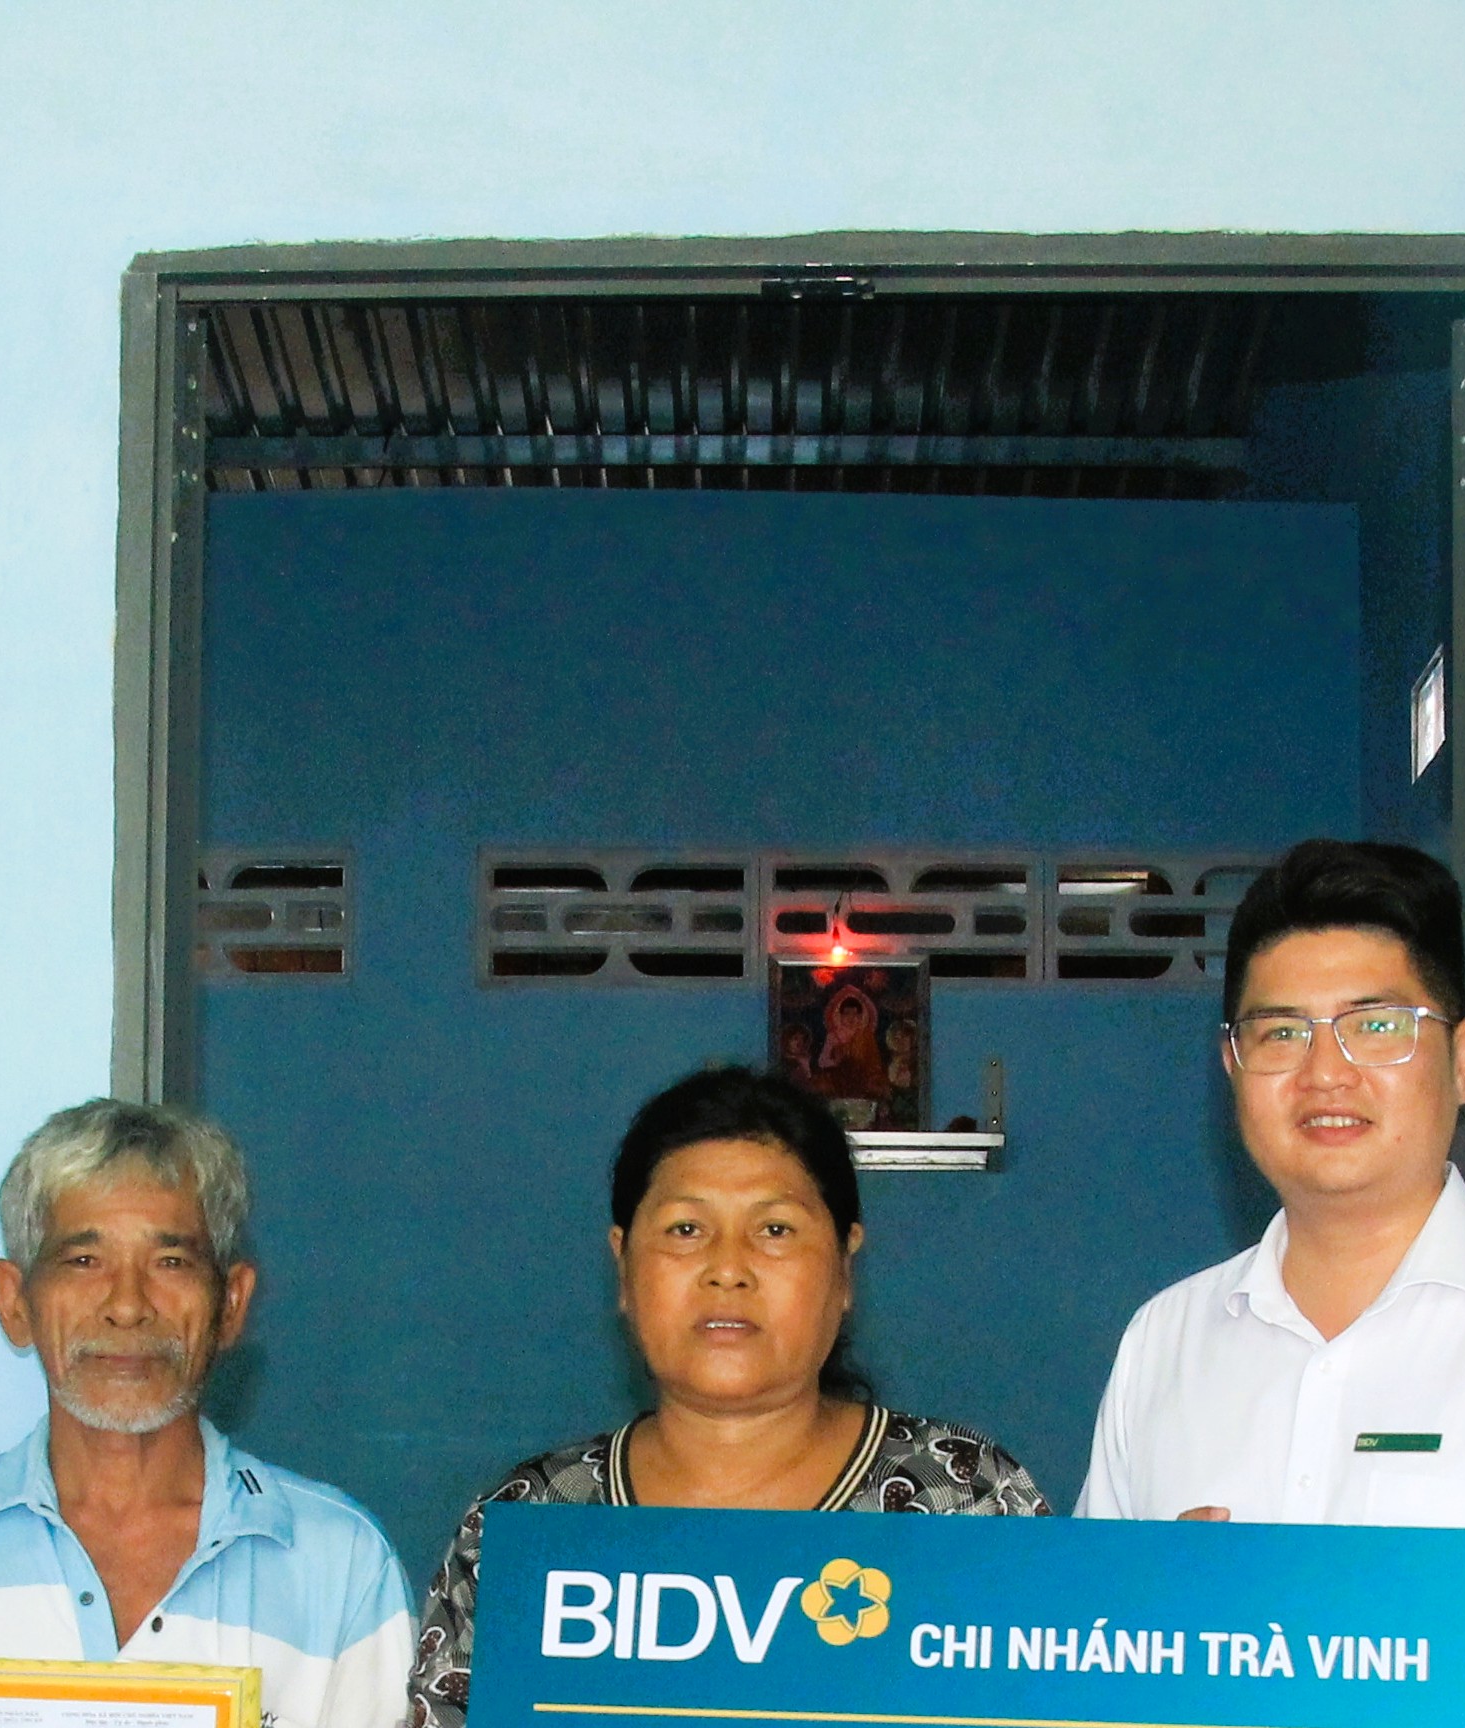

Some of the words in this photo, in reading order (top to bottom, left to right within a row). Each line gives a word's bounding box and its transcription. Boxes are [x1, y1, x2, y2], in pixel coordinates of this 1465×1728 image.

[541, 1569, 802, 1663] BIDV
[910, 1623, 993, 1669] CHI
[1007, 1617, 1185, 1676] NHÁNH
[1200, 1622, 1295, 1678] TRÀ
[1308, 1636, 1429, 1682] VINH
